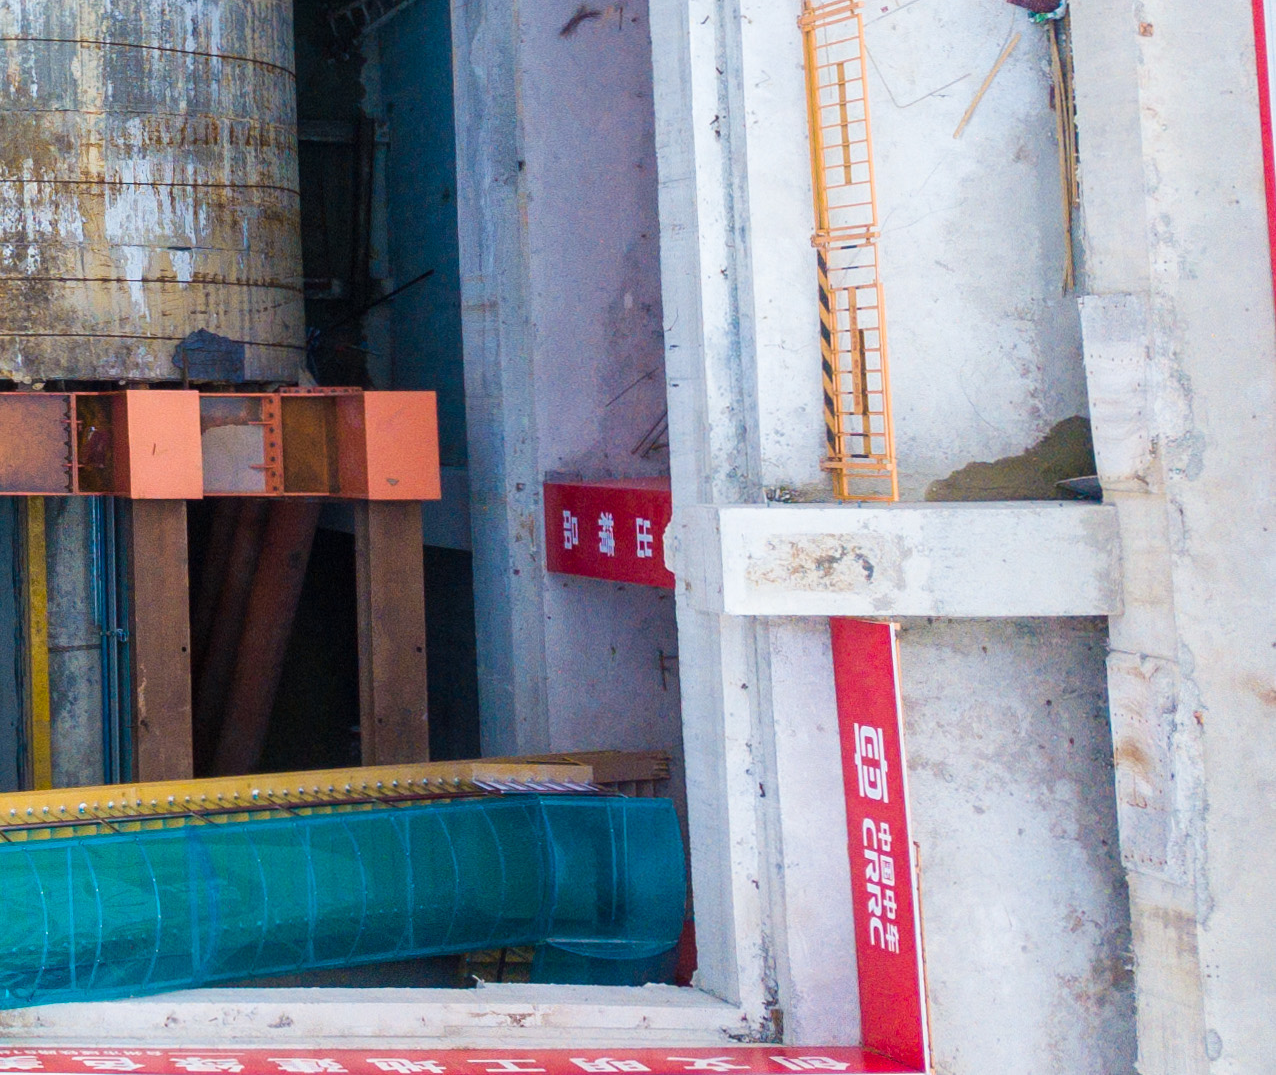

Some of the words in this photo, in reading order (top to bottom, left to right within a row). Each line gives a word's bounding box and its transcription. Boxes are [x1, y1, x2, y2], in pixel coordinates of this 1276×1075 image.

[563, 510, 654, 558] 出精品
[862, 818, 886, 949] CRRC
[877, 822, 900, 953] 中国中车
